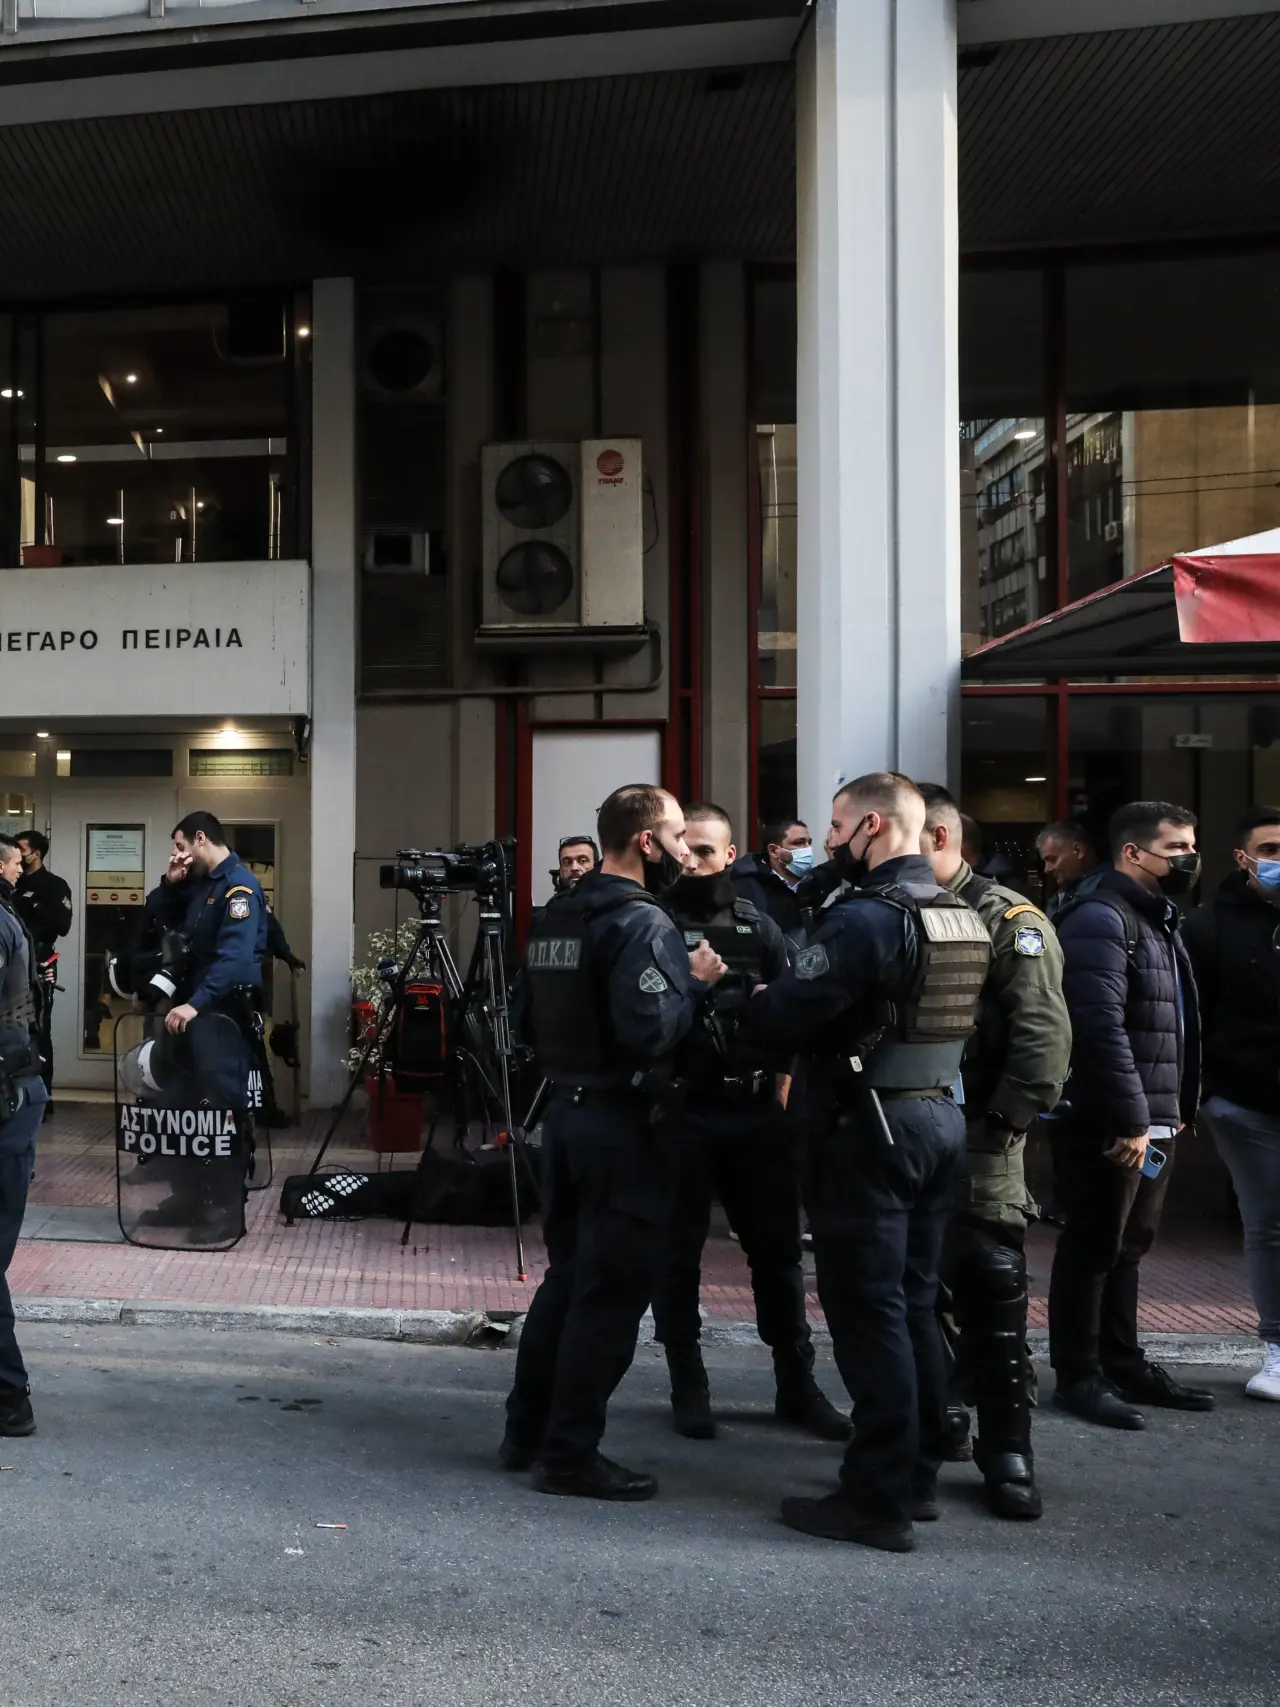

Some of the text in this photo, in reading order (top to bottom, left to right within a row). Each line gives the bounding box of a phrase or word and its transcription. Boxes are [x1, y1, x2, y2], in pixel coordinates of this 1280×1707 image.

[122, 628, 243, 650] ΠΕΙΡΑΙΑ
[120, 1105, 237, 1135] ΑΣΤΥΝΟΜΙΑ
[124, 1131, 232, 1156] POLICE
